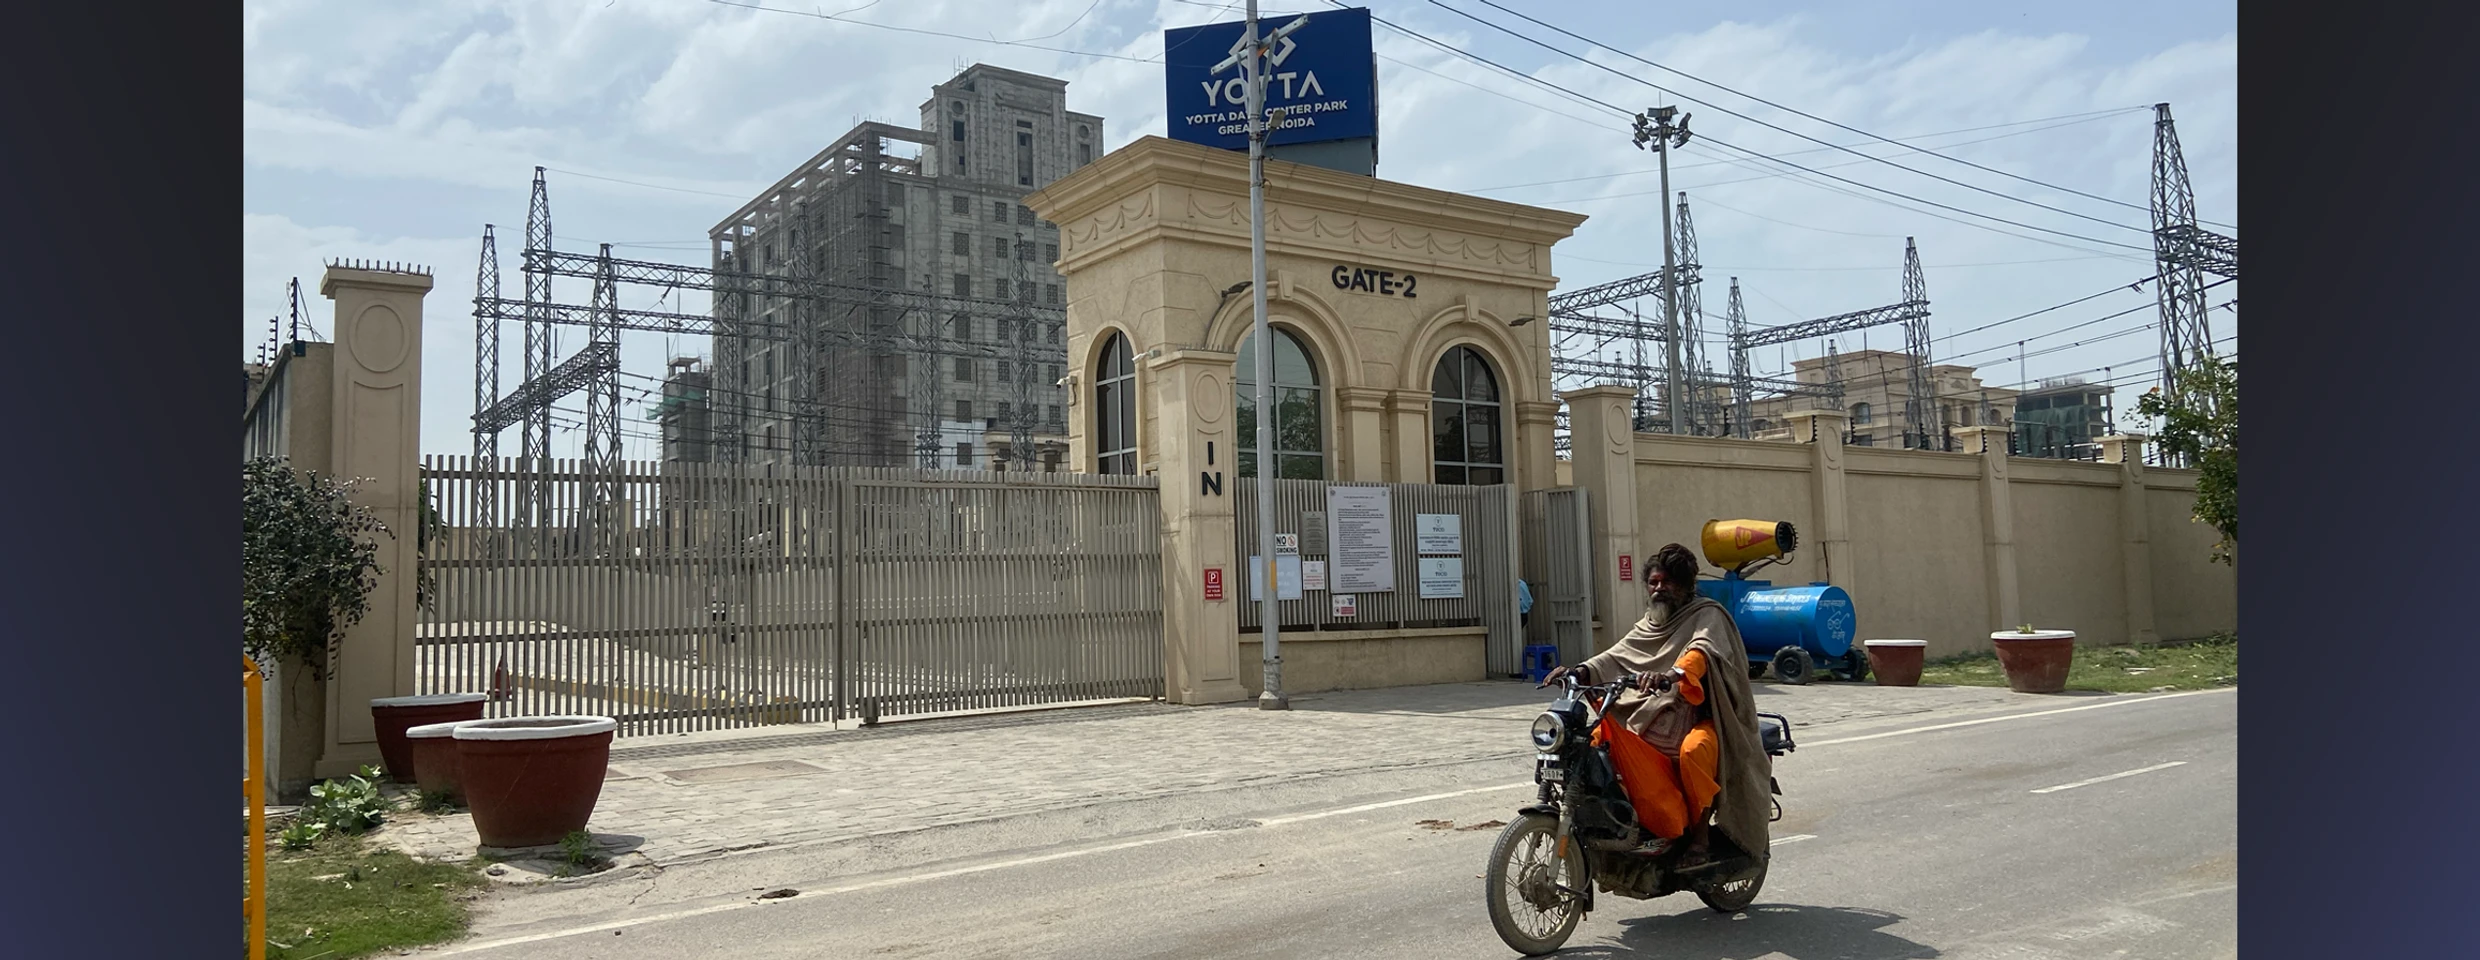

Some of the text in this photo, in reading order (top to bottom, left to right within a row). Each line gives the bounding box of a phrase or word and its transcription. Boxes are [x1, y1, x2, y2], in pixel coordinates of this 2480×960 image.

[1186, 113, 1226, 125] YOTTA
[1315, 100, 1348, 112] PARK
[1332, 265, 1417, 298] GATE-2
[1276, 536, 1287, 545] NO
